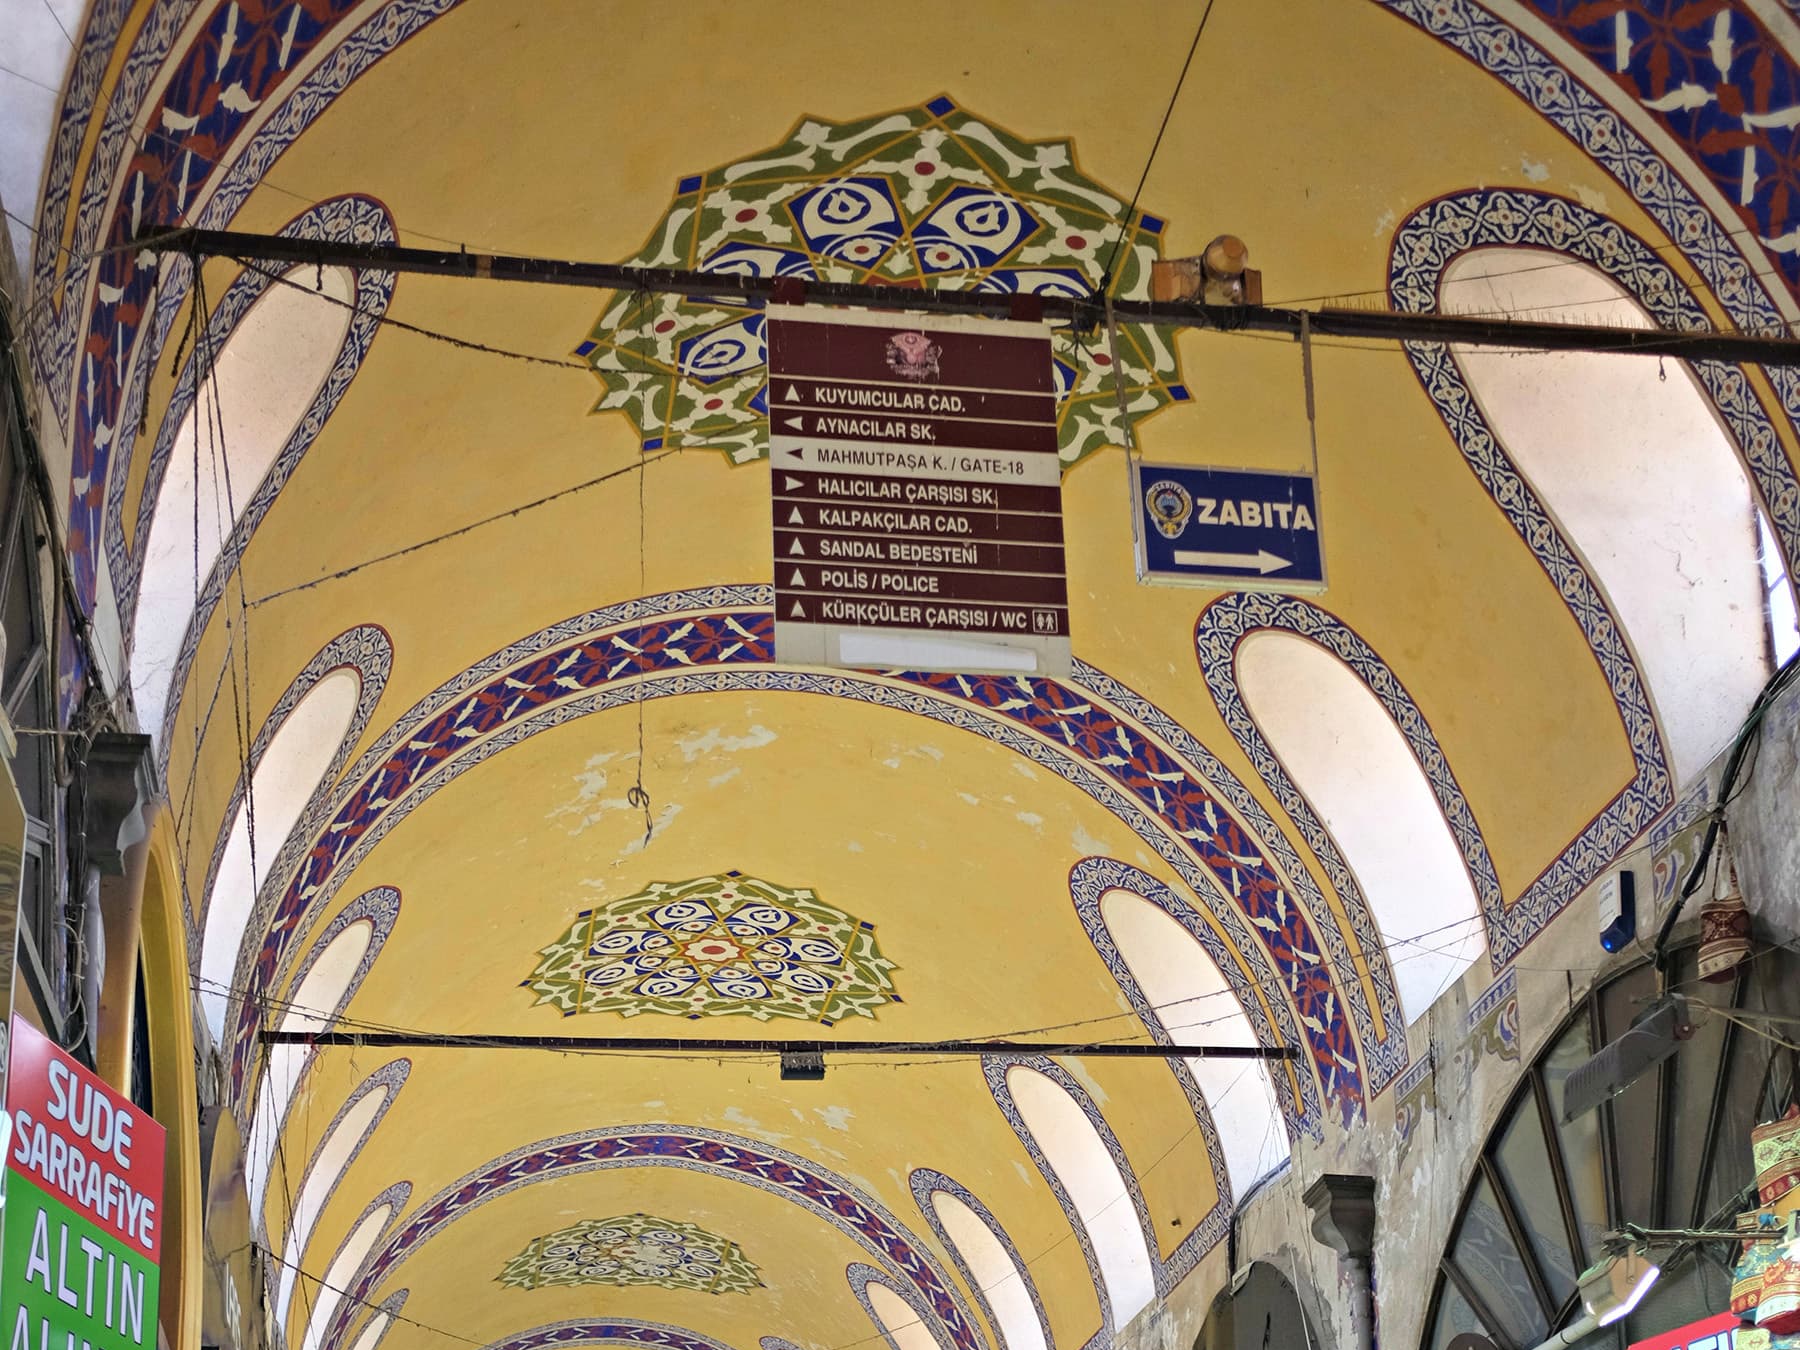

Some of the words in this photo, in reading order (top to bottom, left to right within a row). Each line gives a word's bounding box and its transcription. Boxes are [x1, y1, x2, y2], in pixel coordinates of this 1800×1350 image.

[815, 387, 925, 410] KUYUMCULAR
[928, 395, 966, 413] CAD.
[816, 417, 907, 439] AYNACILAR
[910, 423, 936, 441] SK.
[817, 448, 928, 473] MAHMUTPAŞA
[932, 455, 947, 471] K.
[951, 457, 957, 471] /
[960, 457, 1024, 476] GATE-18
[818, 478, 901, 500] HALICILAR
[906, 483, 968, 505] ÇARŞISI
[819, 509, 931, 534] KALPAKÇILAR
[935, 515, 972, 533] CAD.
[1197, 498, 1315, 531] ZABITA
[820, 539, 885, 560] SANDAL
[890, 542, 978, 565] BEDESTENİ
[821, 568, 868, 590] POLİS
[872, 573, 878, 589] /
[881, 573, 939, 593] POLICE
[822, 600, 921, 624] KÜRKÇÜLER
[926, 608, 989, 629] ÇARŞISI
[992, 611, 998, 627] /
[1001, 611, 1027, 629] WC
[47, 1058, 134, 1170] SUDE
[25, 1207, 145, 1346] ALTIN
